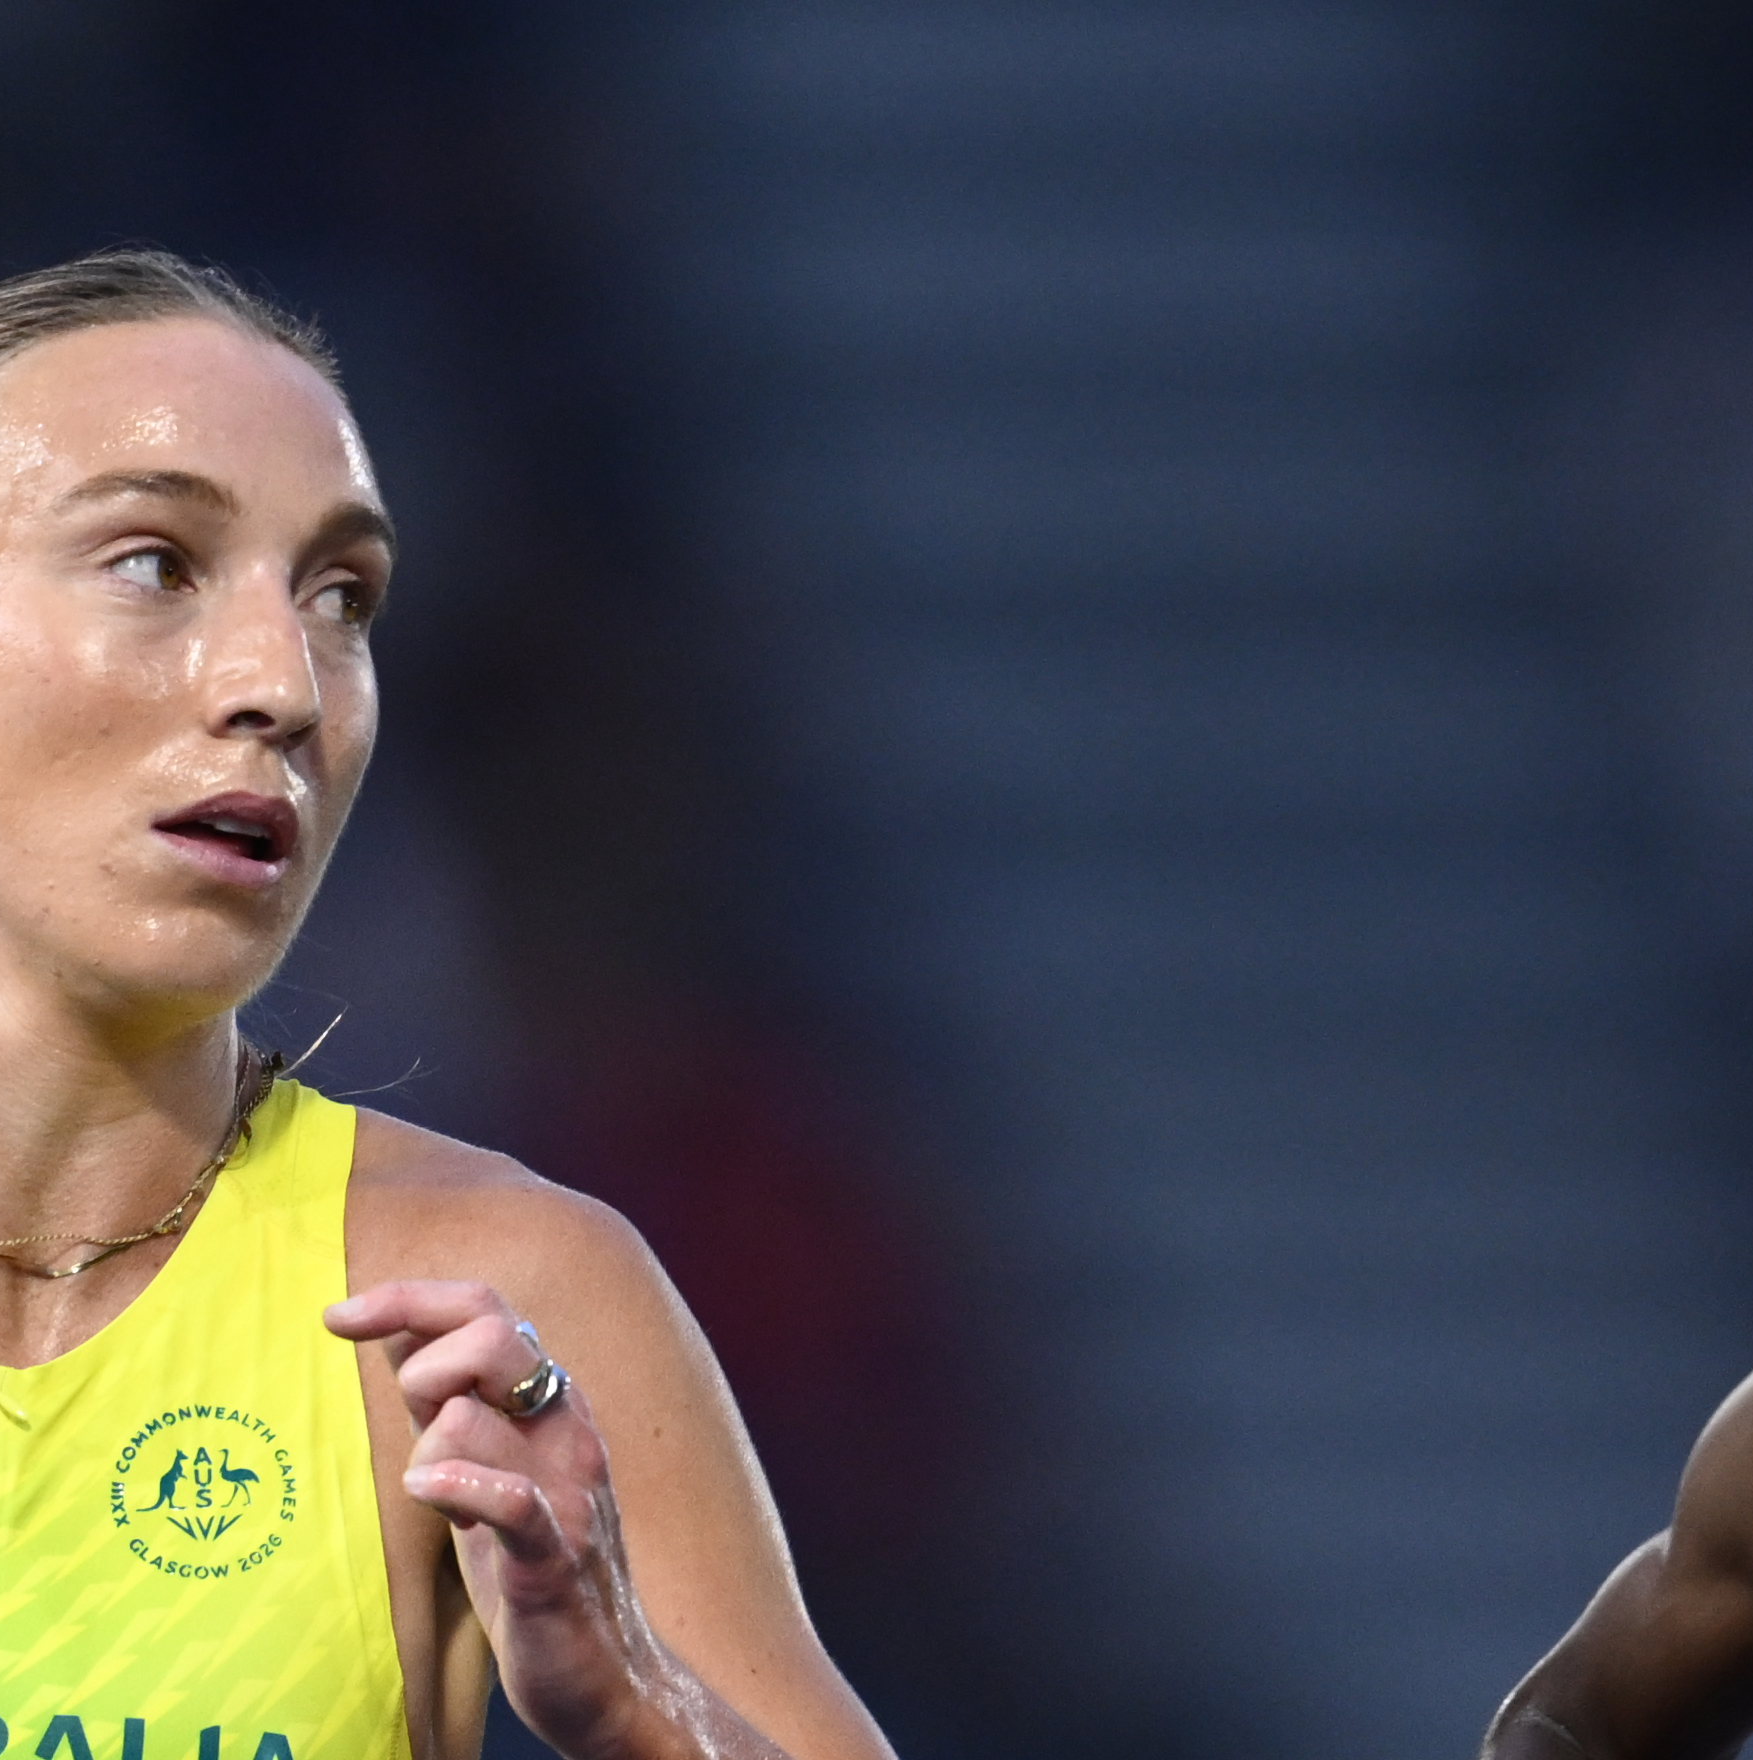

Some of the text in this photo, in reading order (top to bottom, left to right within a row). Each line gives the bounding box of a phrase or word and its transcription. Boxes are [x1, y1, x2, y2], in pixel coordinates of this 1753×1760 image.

[116, 1404, 276, 1474] COMMONWEALTH
[274, 1448, 297, 1522] GAMES
[129, 1533, 283, 1580] GLASGOW 2026
